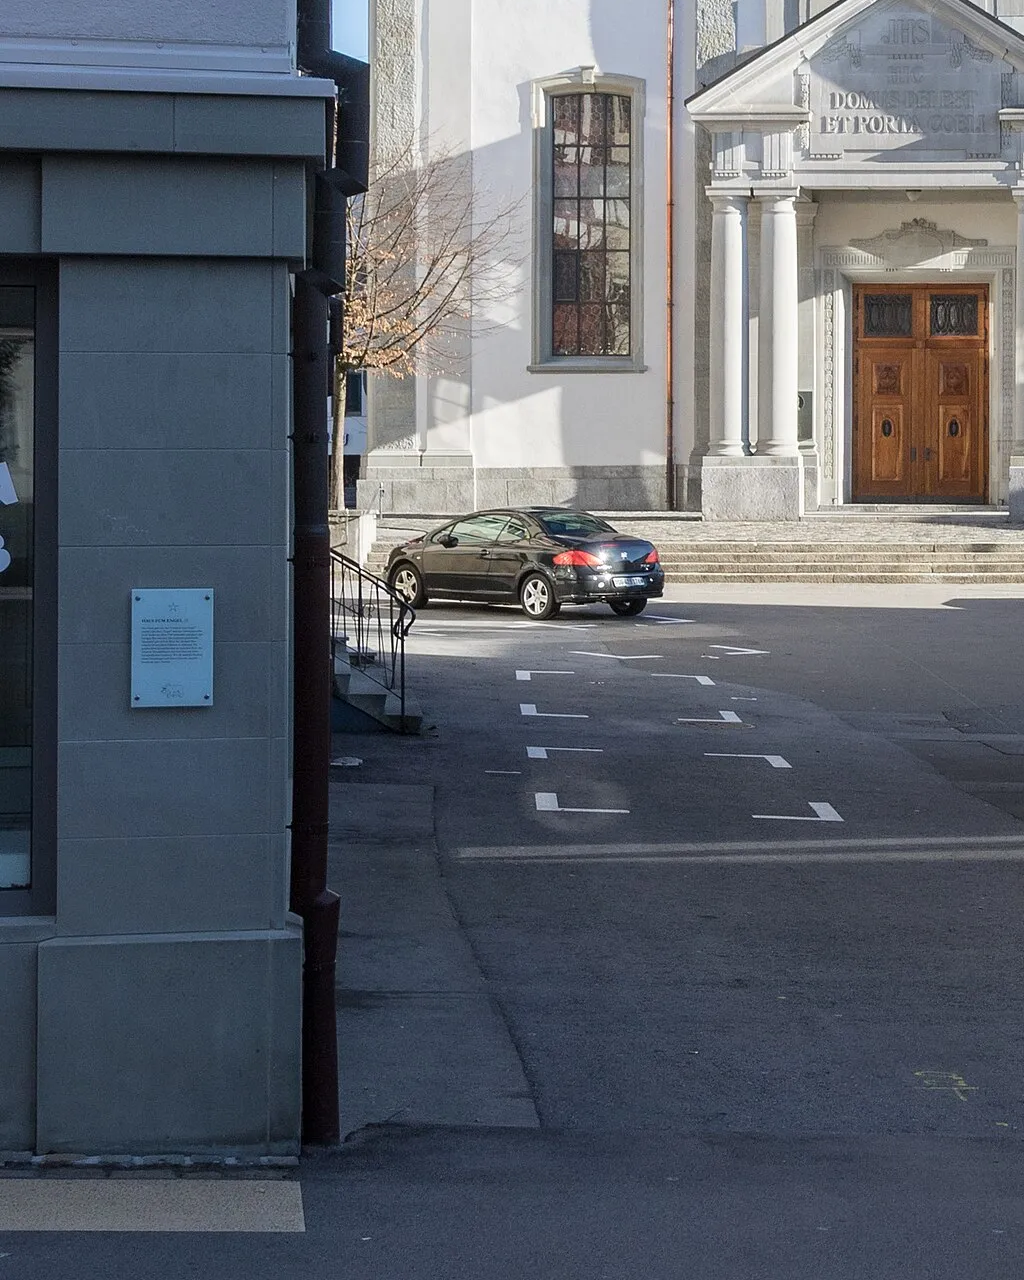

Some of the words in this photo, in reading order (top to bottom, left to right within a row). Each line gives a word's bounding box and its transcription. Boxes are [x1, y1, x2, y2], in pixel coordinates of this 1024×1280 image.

[831, 91, 899, 109] DOMUS
[822, 114, 852, 134] ET
[855, 114, 924, 134] PORTA
